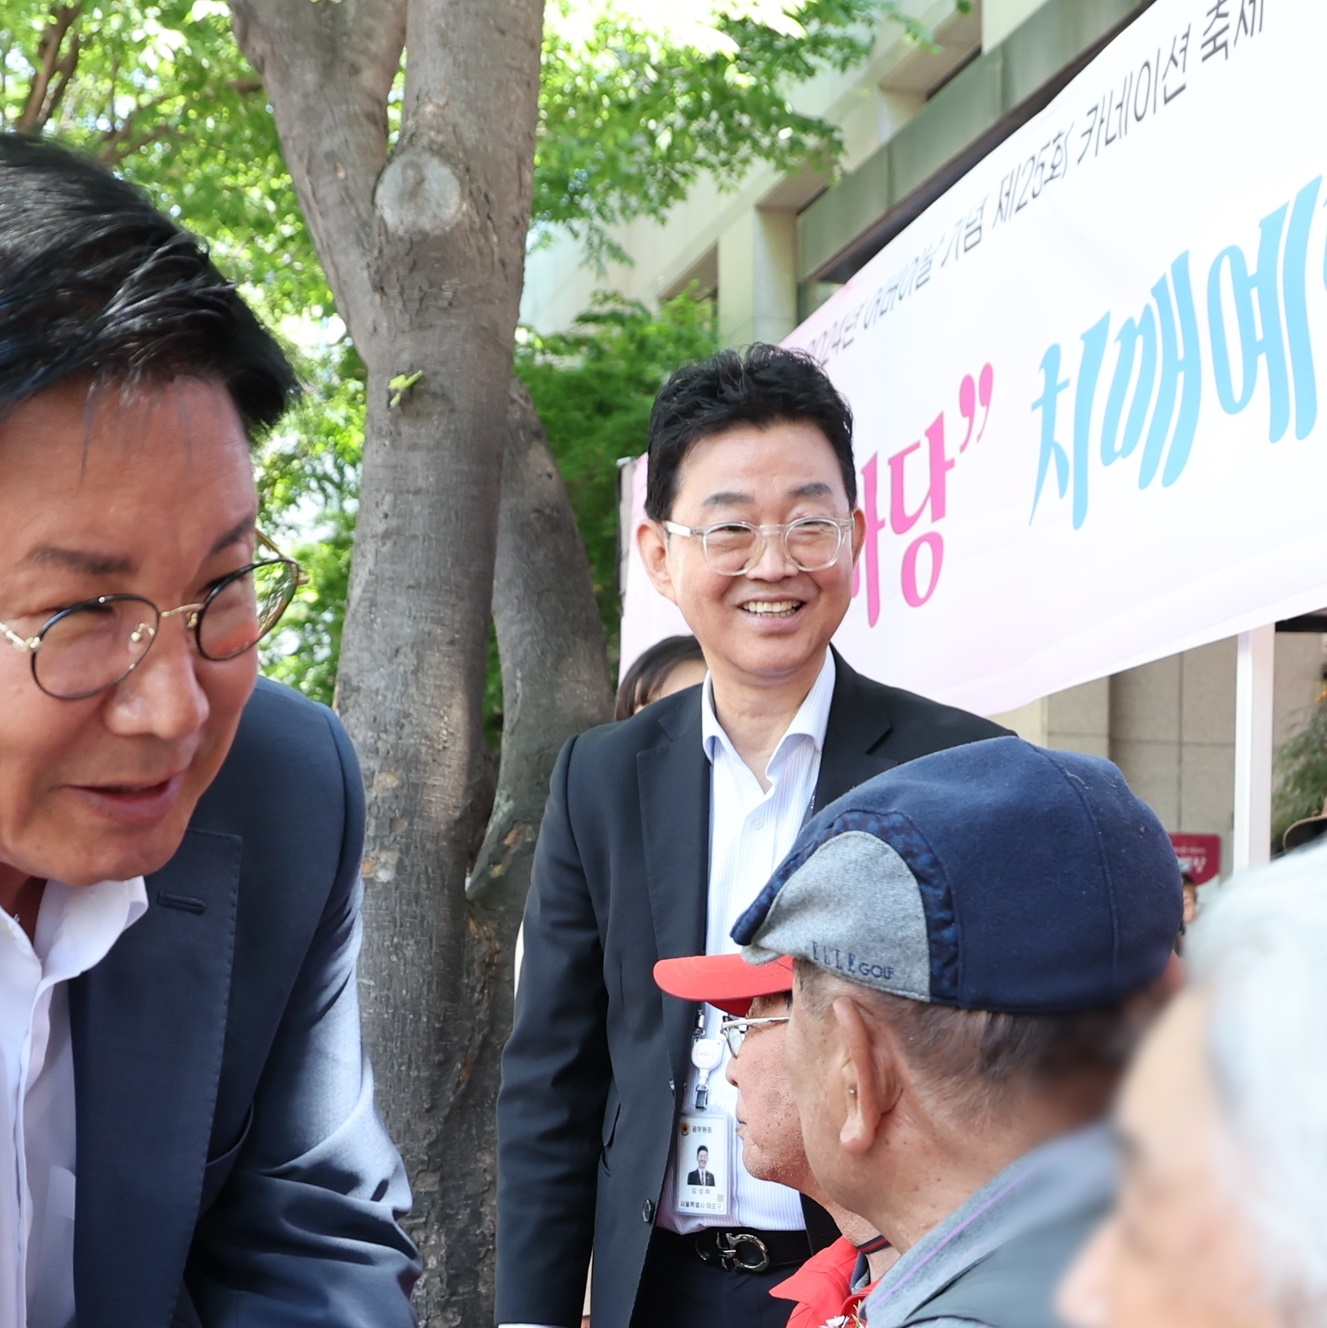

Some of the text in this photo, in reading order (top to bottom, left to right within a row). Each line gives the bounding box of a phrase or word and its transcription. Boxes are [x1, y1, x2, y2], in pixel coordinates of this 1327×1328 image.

[940, 203, 985, 268] 기념
[992, 122, 1074, 229] 제25회
[1077, 23, 1191, 164] 카네이션
[858, 961, 895, 980] GOLF
